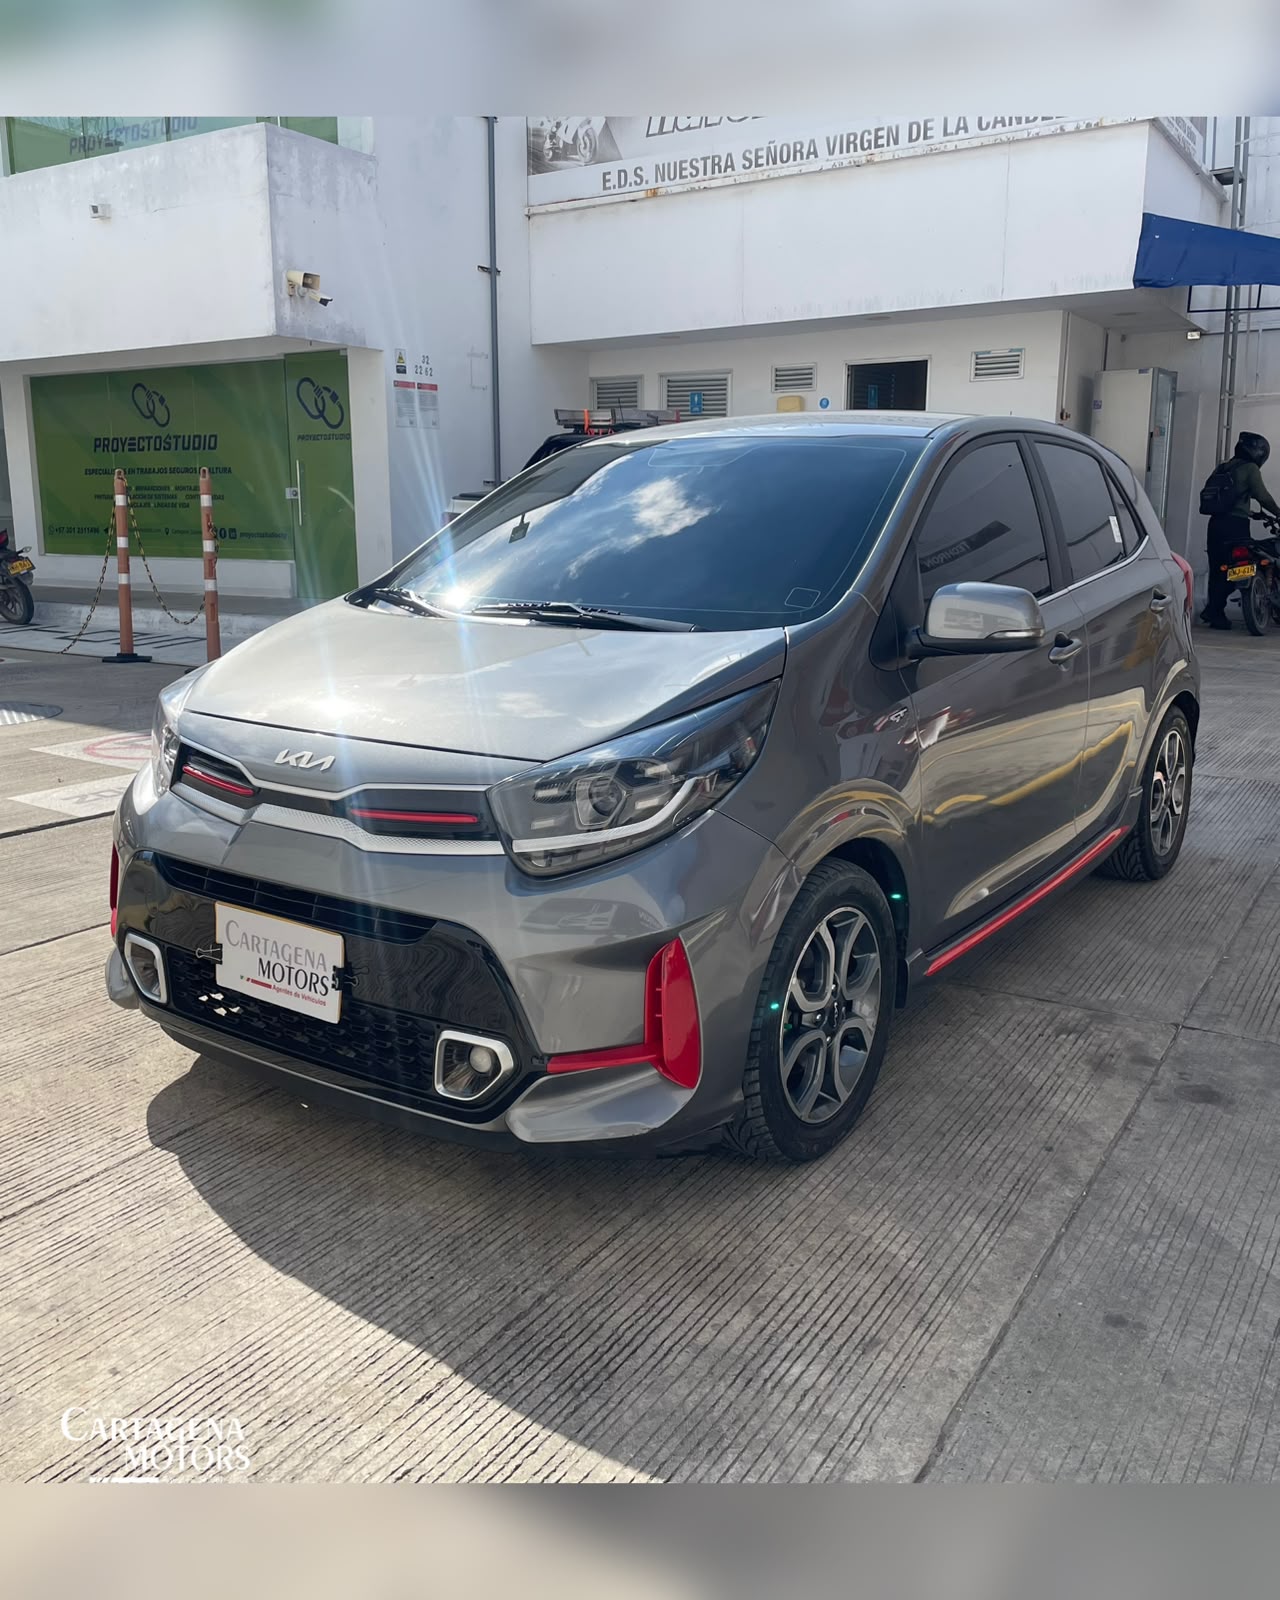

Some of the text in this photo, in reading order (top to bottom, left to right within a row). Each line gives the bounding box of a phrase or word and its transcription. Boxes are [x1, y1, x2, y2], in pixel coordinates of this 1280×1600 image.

[602, 165, 649, 191] E.D.S.
[654, 152, 736, 184] NUESTRA
[742, 139, 819, 170] SEÑORA
[825, 123, 900, 156] VIRGEN
[907, 117, 935, 144] DE
[942, 116, 969, 138] LA
[421, 354, 430, 365] 32
[136, 467, 168, 475] TRABAJOS
[168, 466, 197, 474] SEGUROS
[273, 748, 336, 771] KIA
[225, 919, 328, 972] CARTAGENA
[258, 957, 329, 997] MOTORS
